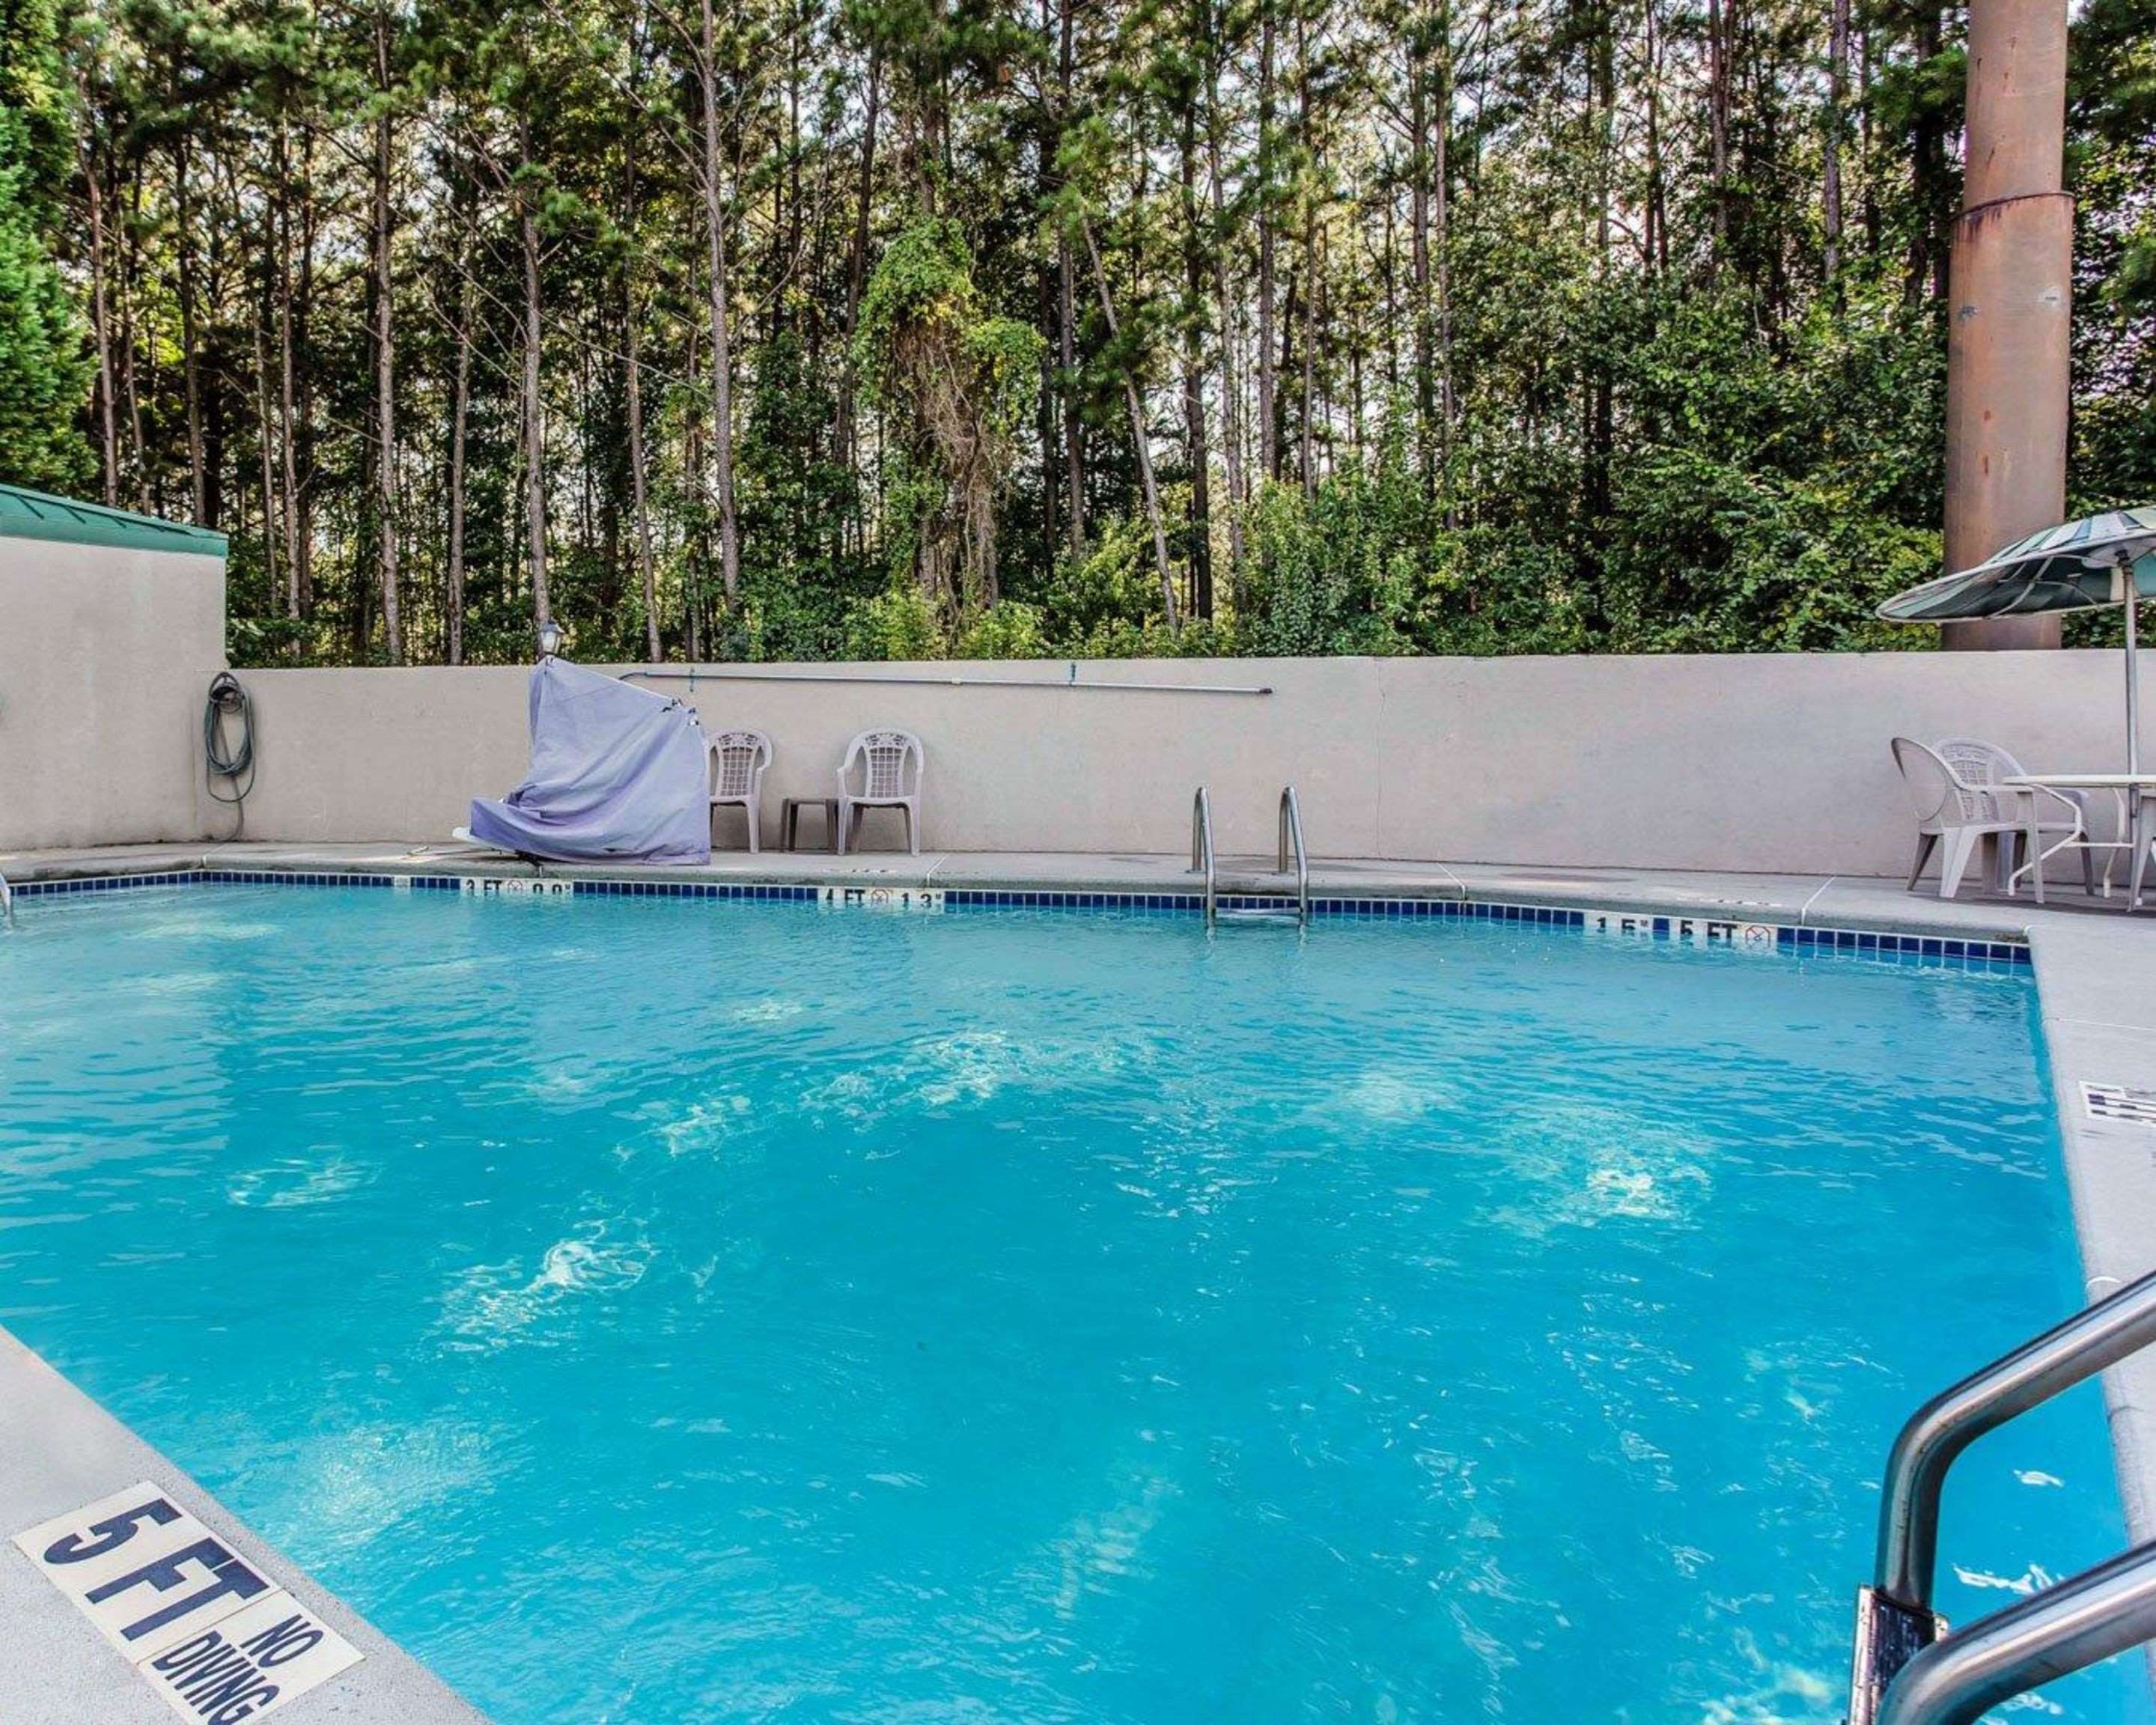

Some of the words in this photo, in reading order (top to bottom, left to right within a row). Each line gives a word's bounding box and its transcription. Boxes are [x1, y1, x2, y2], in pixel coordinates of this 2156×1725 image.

[844, 889, 865, 902] FT
[1708, 922, 1738, 938] FT
[43, 1497, 183, 1564] 5
[84, 1536, 270, 1641] FT
[240, 1613, 323, 1668] NO
[152, 1630, 280, 1725] DIVING
